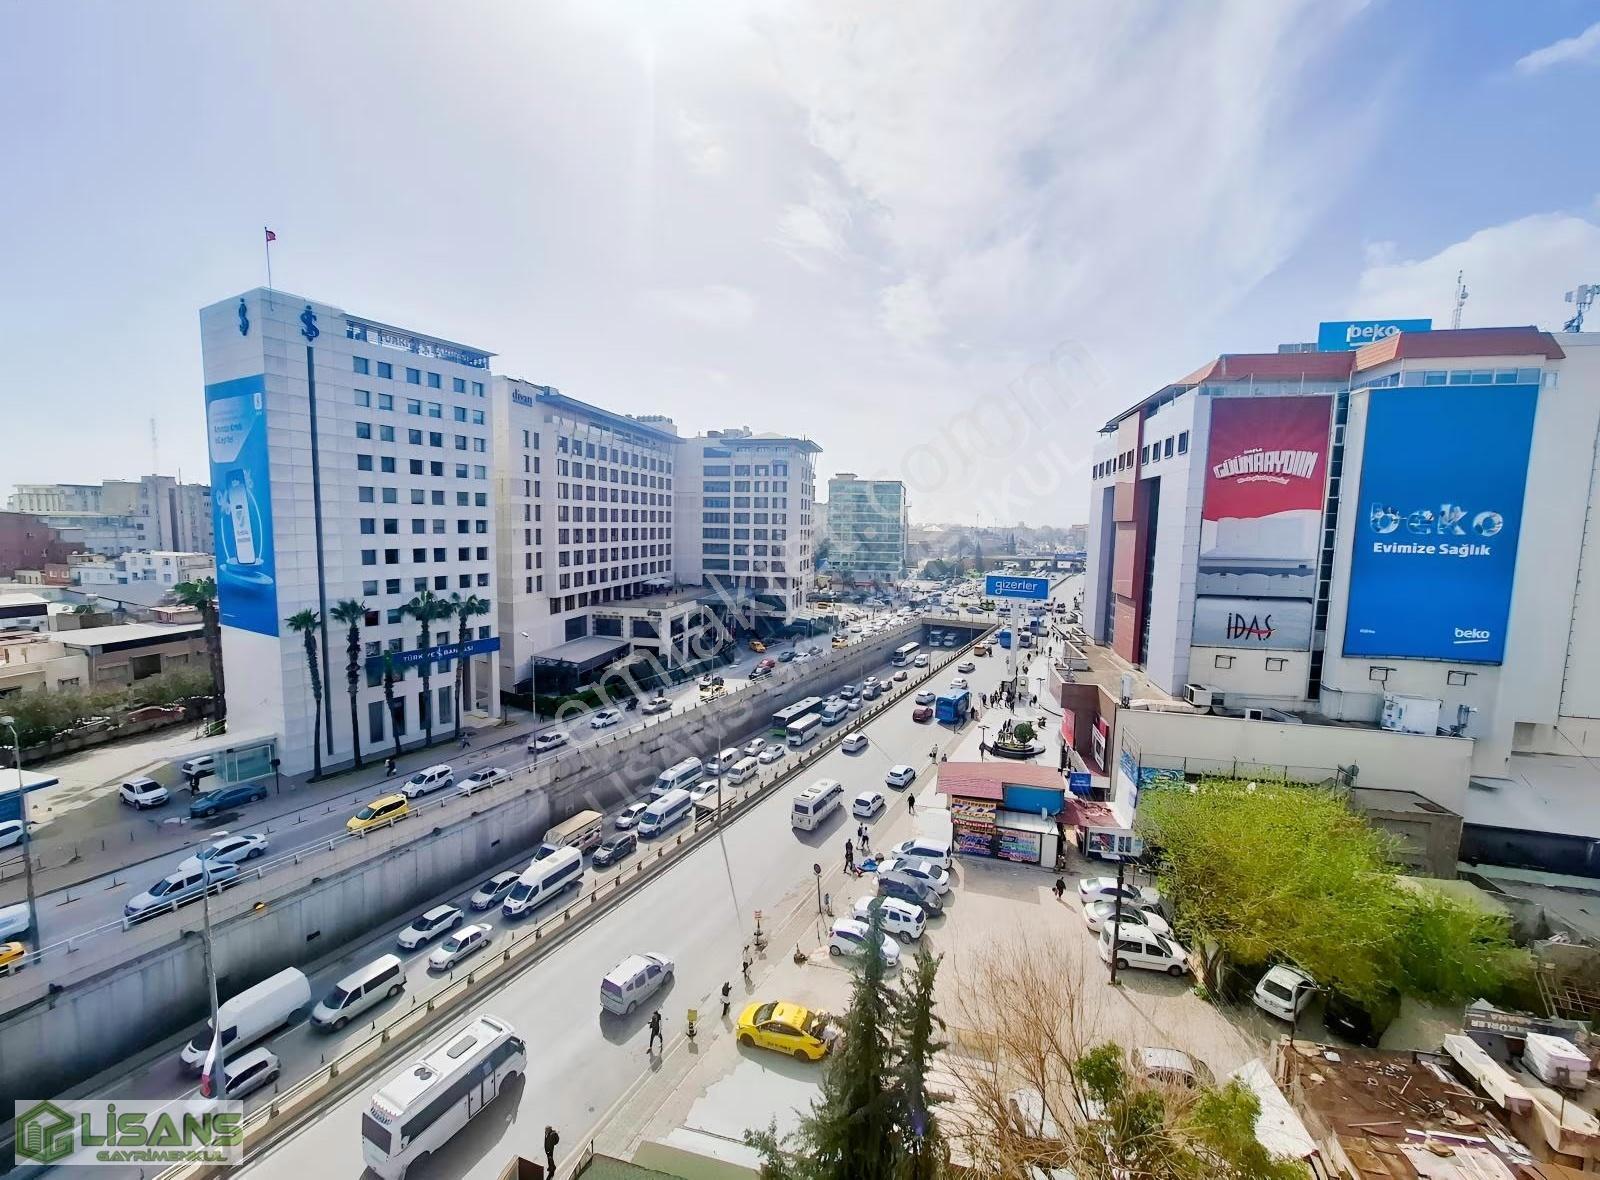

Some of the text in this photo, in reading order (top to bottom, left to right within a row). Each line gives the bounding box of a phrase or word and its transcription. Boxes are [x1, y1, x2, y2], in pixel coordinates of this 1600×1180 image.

[512, 388, 533, 405] divan
[1370, 502, 1503, 537] beko
[1373, 542, 1492, 558] Evimize Sağlık
[995, 579, 1038, 594] gizerler
[1454, 626, 1490, 640] beko
[402, 645, 474, 662] TÜRKE BANASI
